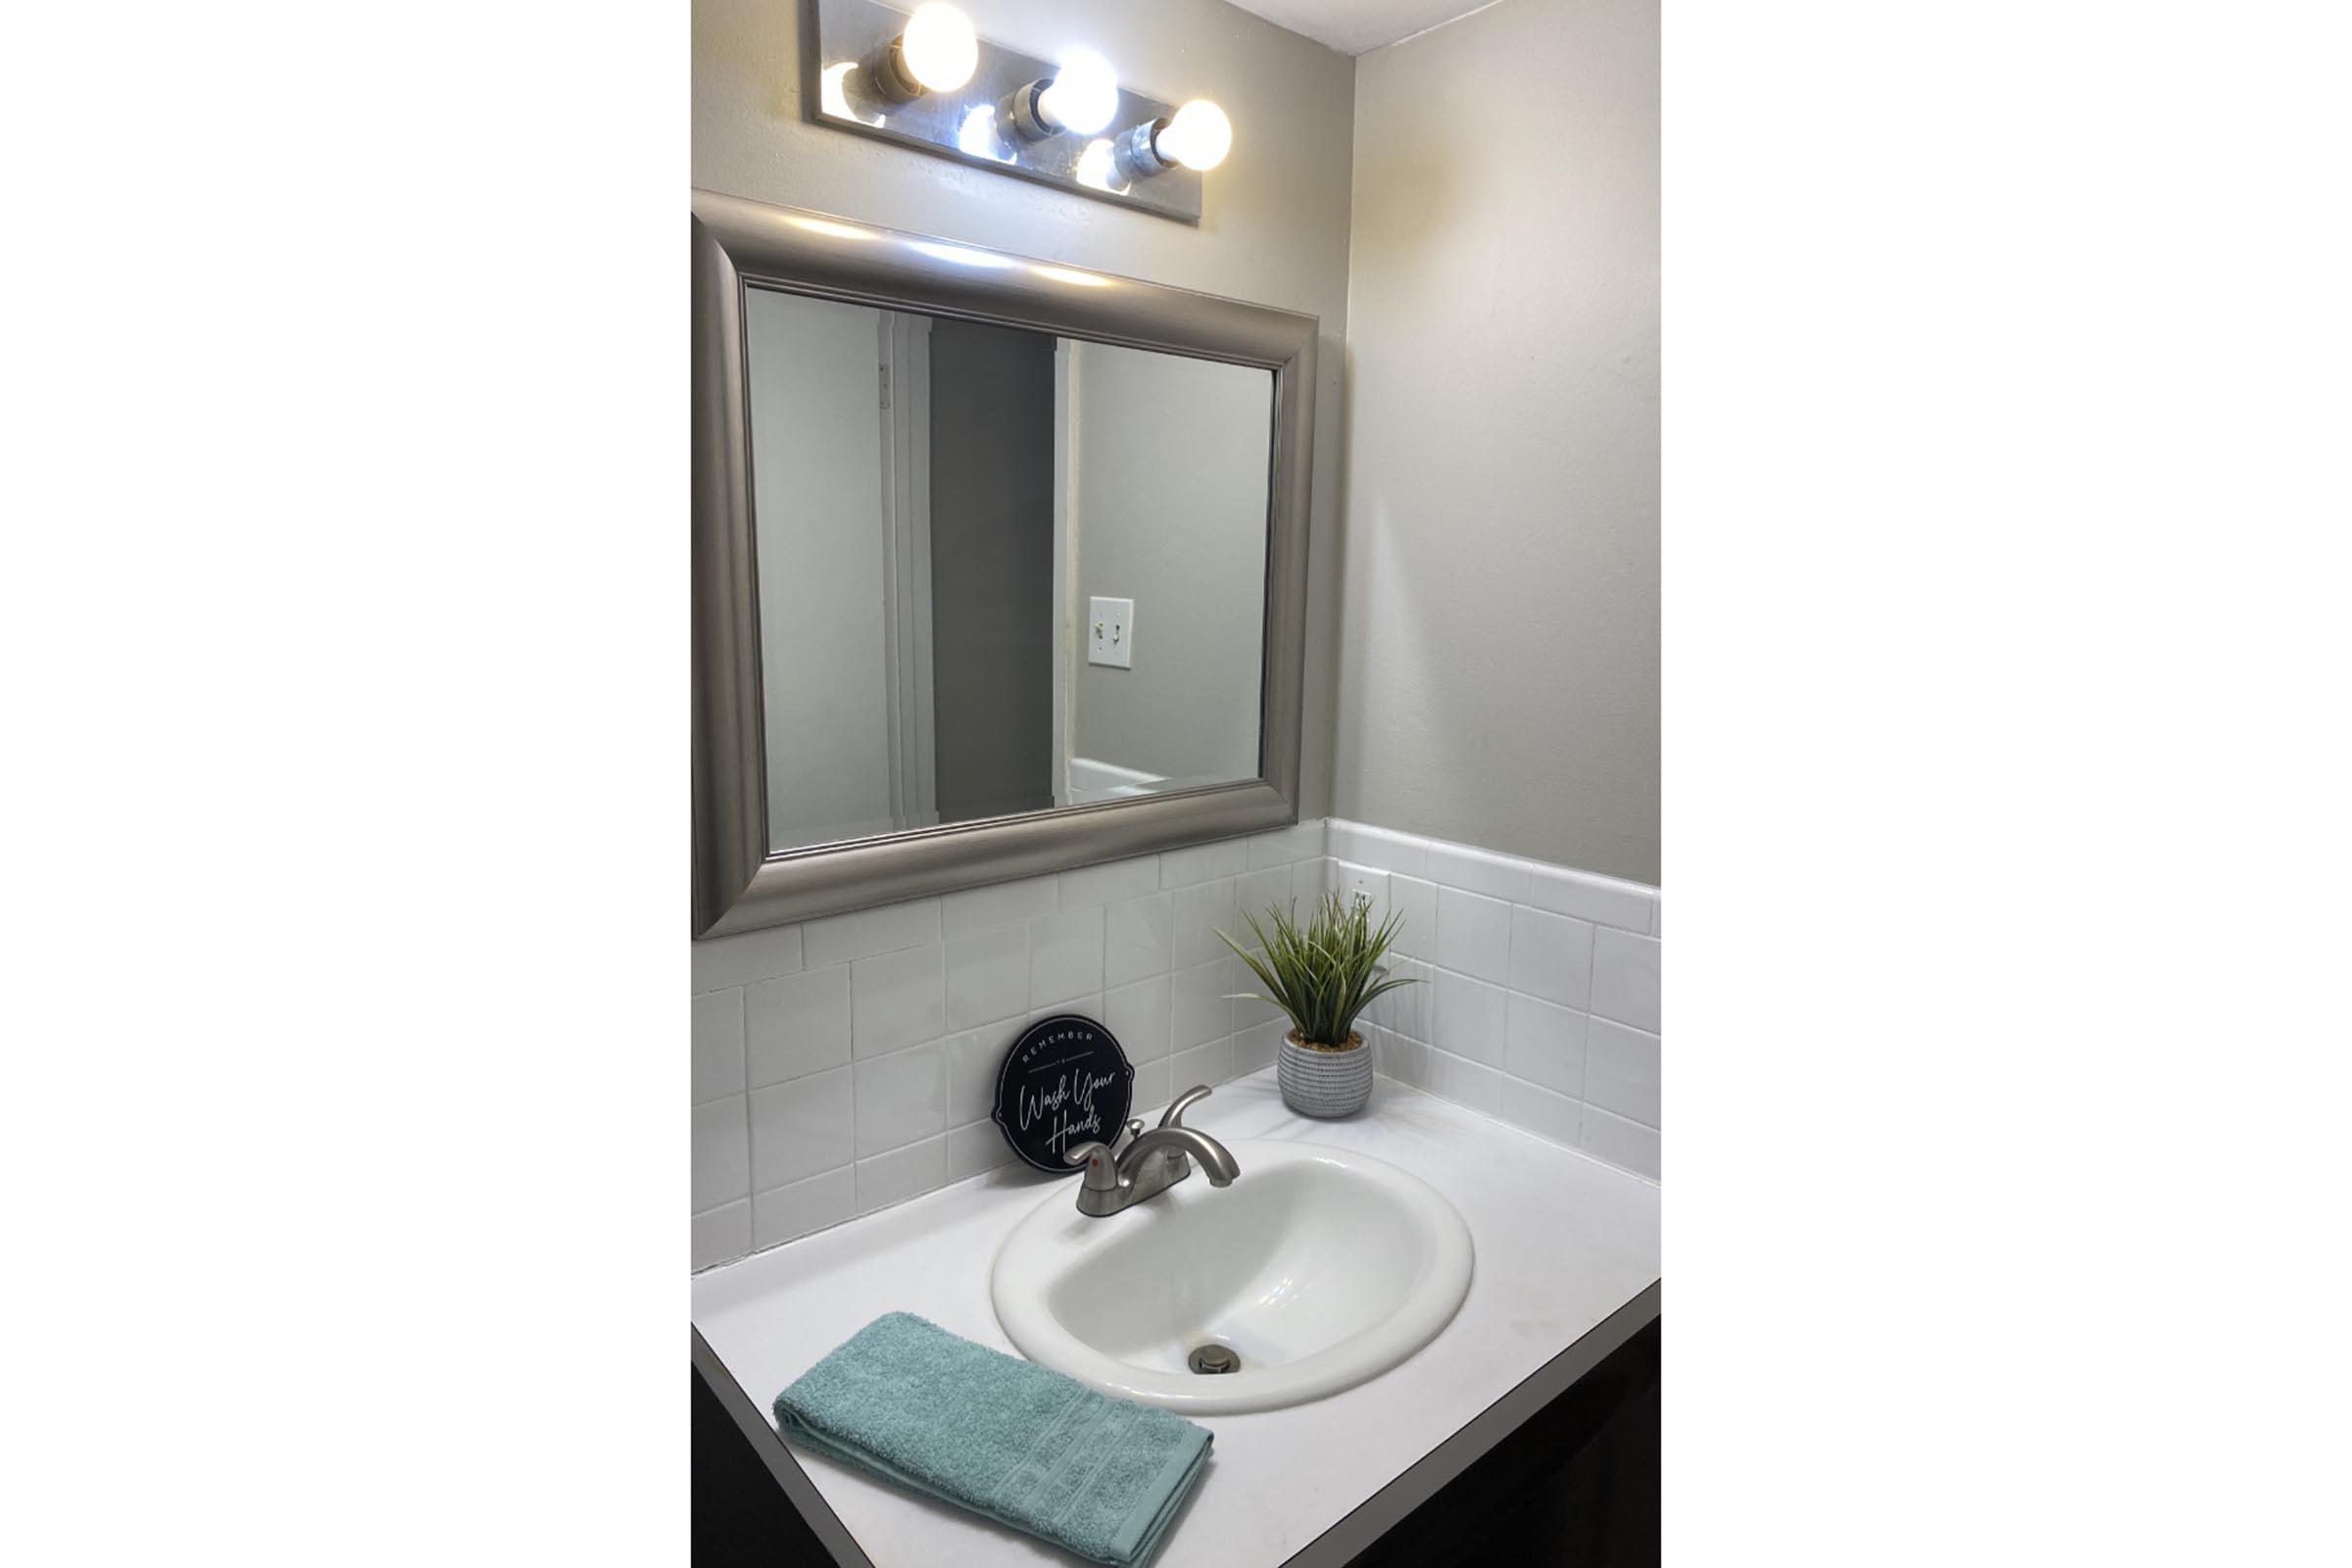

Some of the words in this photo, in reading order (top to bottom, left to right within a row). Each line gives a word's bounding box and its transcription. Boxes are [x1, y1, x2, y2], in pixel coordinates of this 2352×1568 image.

[1022, 1031, 1093, 1063] REMEMBER
[1020, 1074, 1070, 1131] Wash
[1074, 1068, 1115, 1111] Your
[1046, 1104, 1101, 1154] Hands
